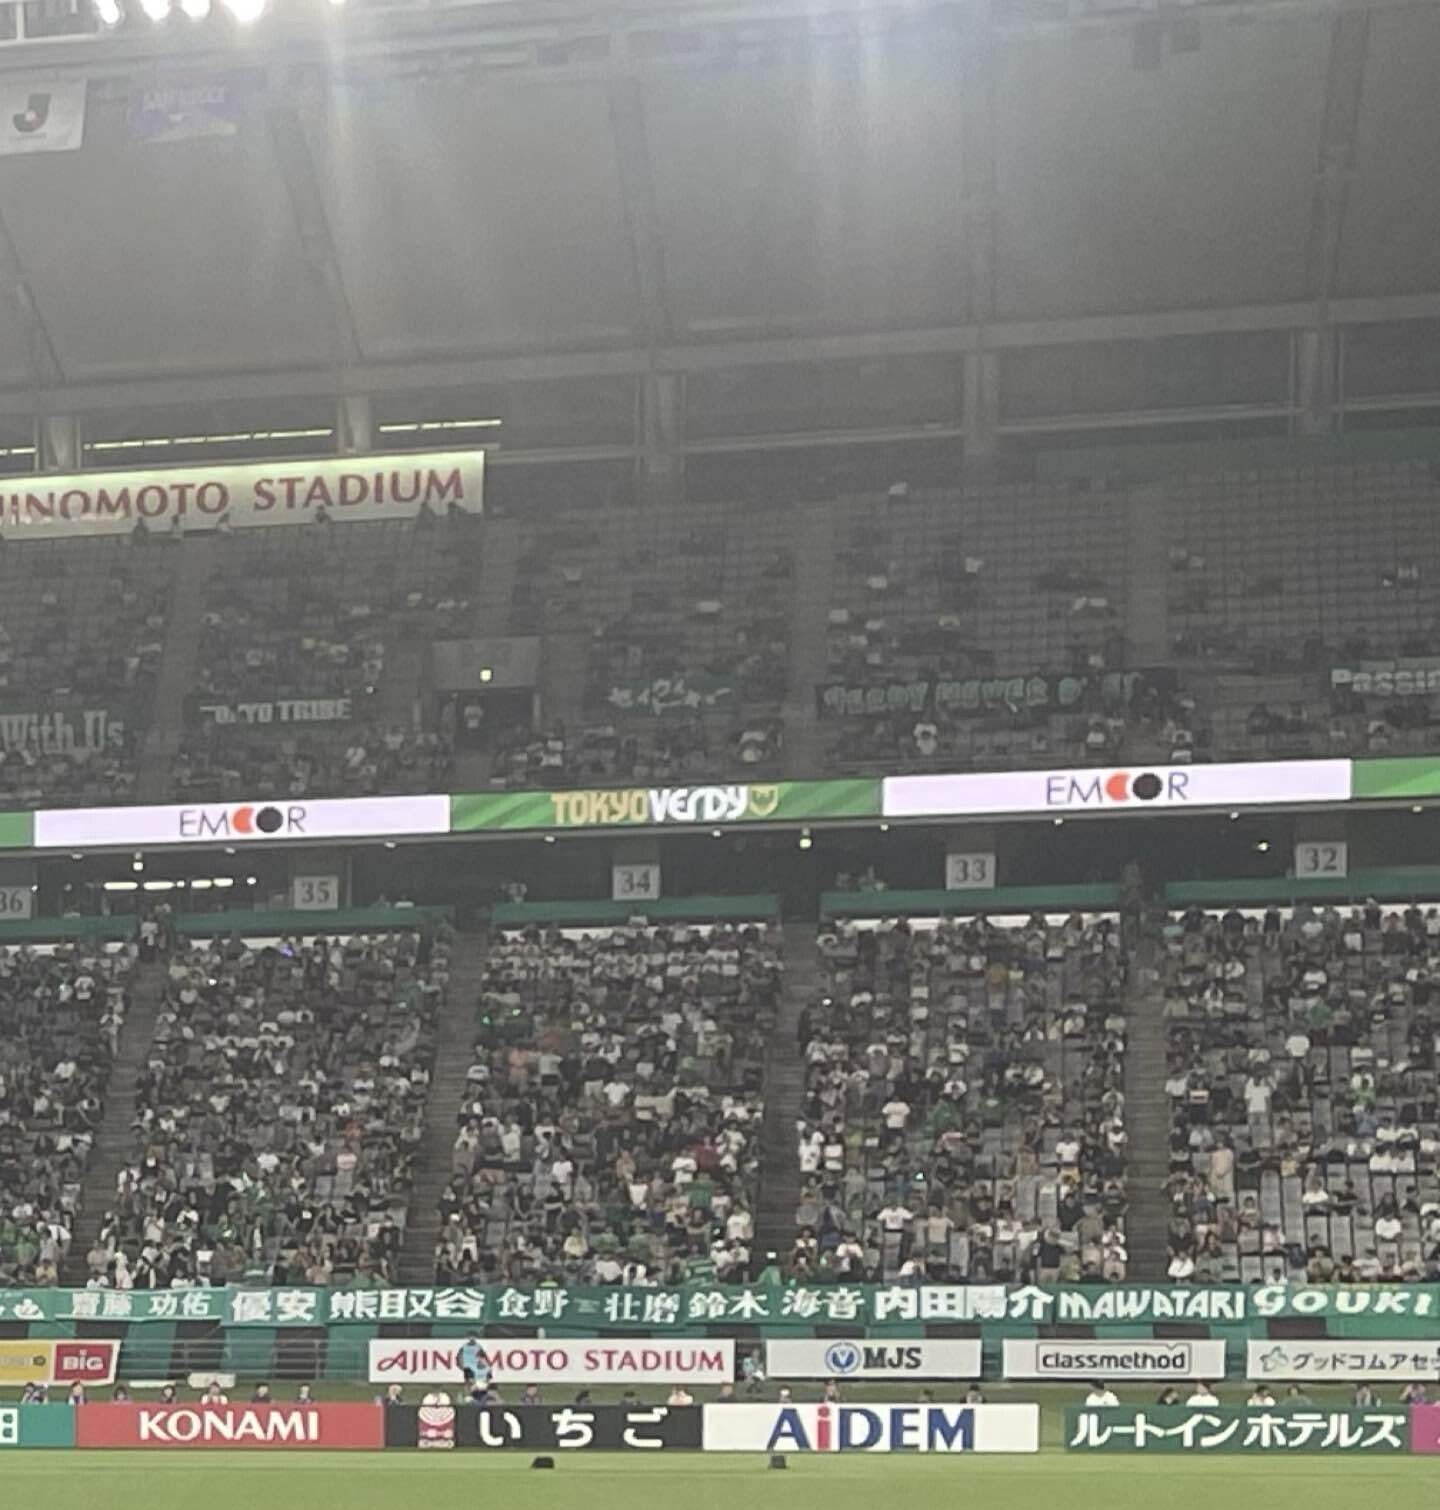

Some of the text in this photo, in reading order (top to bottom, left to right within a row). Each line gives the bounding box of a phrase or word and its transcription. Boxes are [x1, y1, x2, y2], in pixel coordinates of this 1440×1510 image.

[252, 468, 465, 512] STADIUM
[956, 858, 987, 882] 33
[1303, 847, 1338, 872] 32
[301, 881, 330, 904] 35
[622, 871, 651, 894] 34
[687, 1287, 866, 1320] 鈴木 海音
[1059, 1290, 1246, 1321] MAWATARI
[1252, 1286, 1433, 1315] GOUKI
[584, 1349, 725, 1372] STADIUM
[863, 1348, 922, 1369] MJS
[1042, 1350, 1185, 1370] classmethod
[138, 1411, 319, 1443] KONAMI
[480, 1408, 669, 1448] いちご
[1070, 1413, 1407, 1451] ルートインホテルズ
